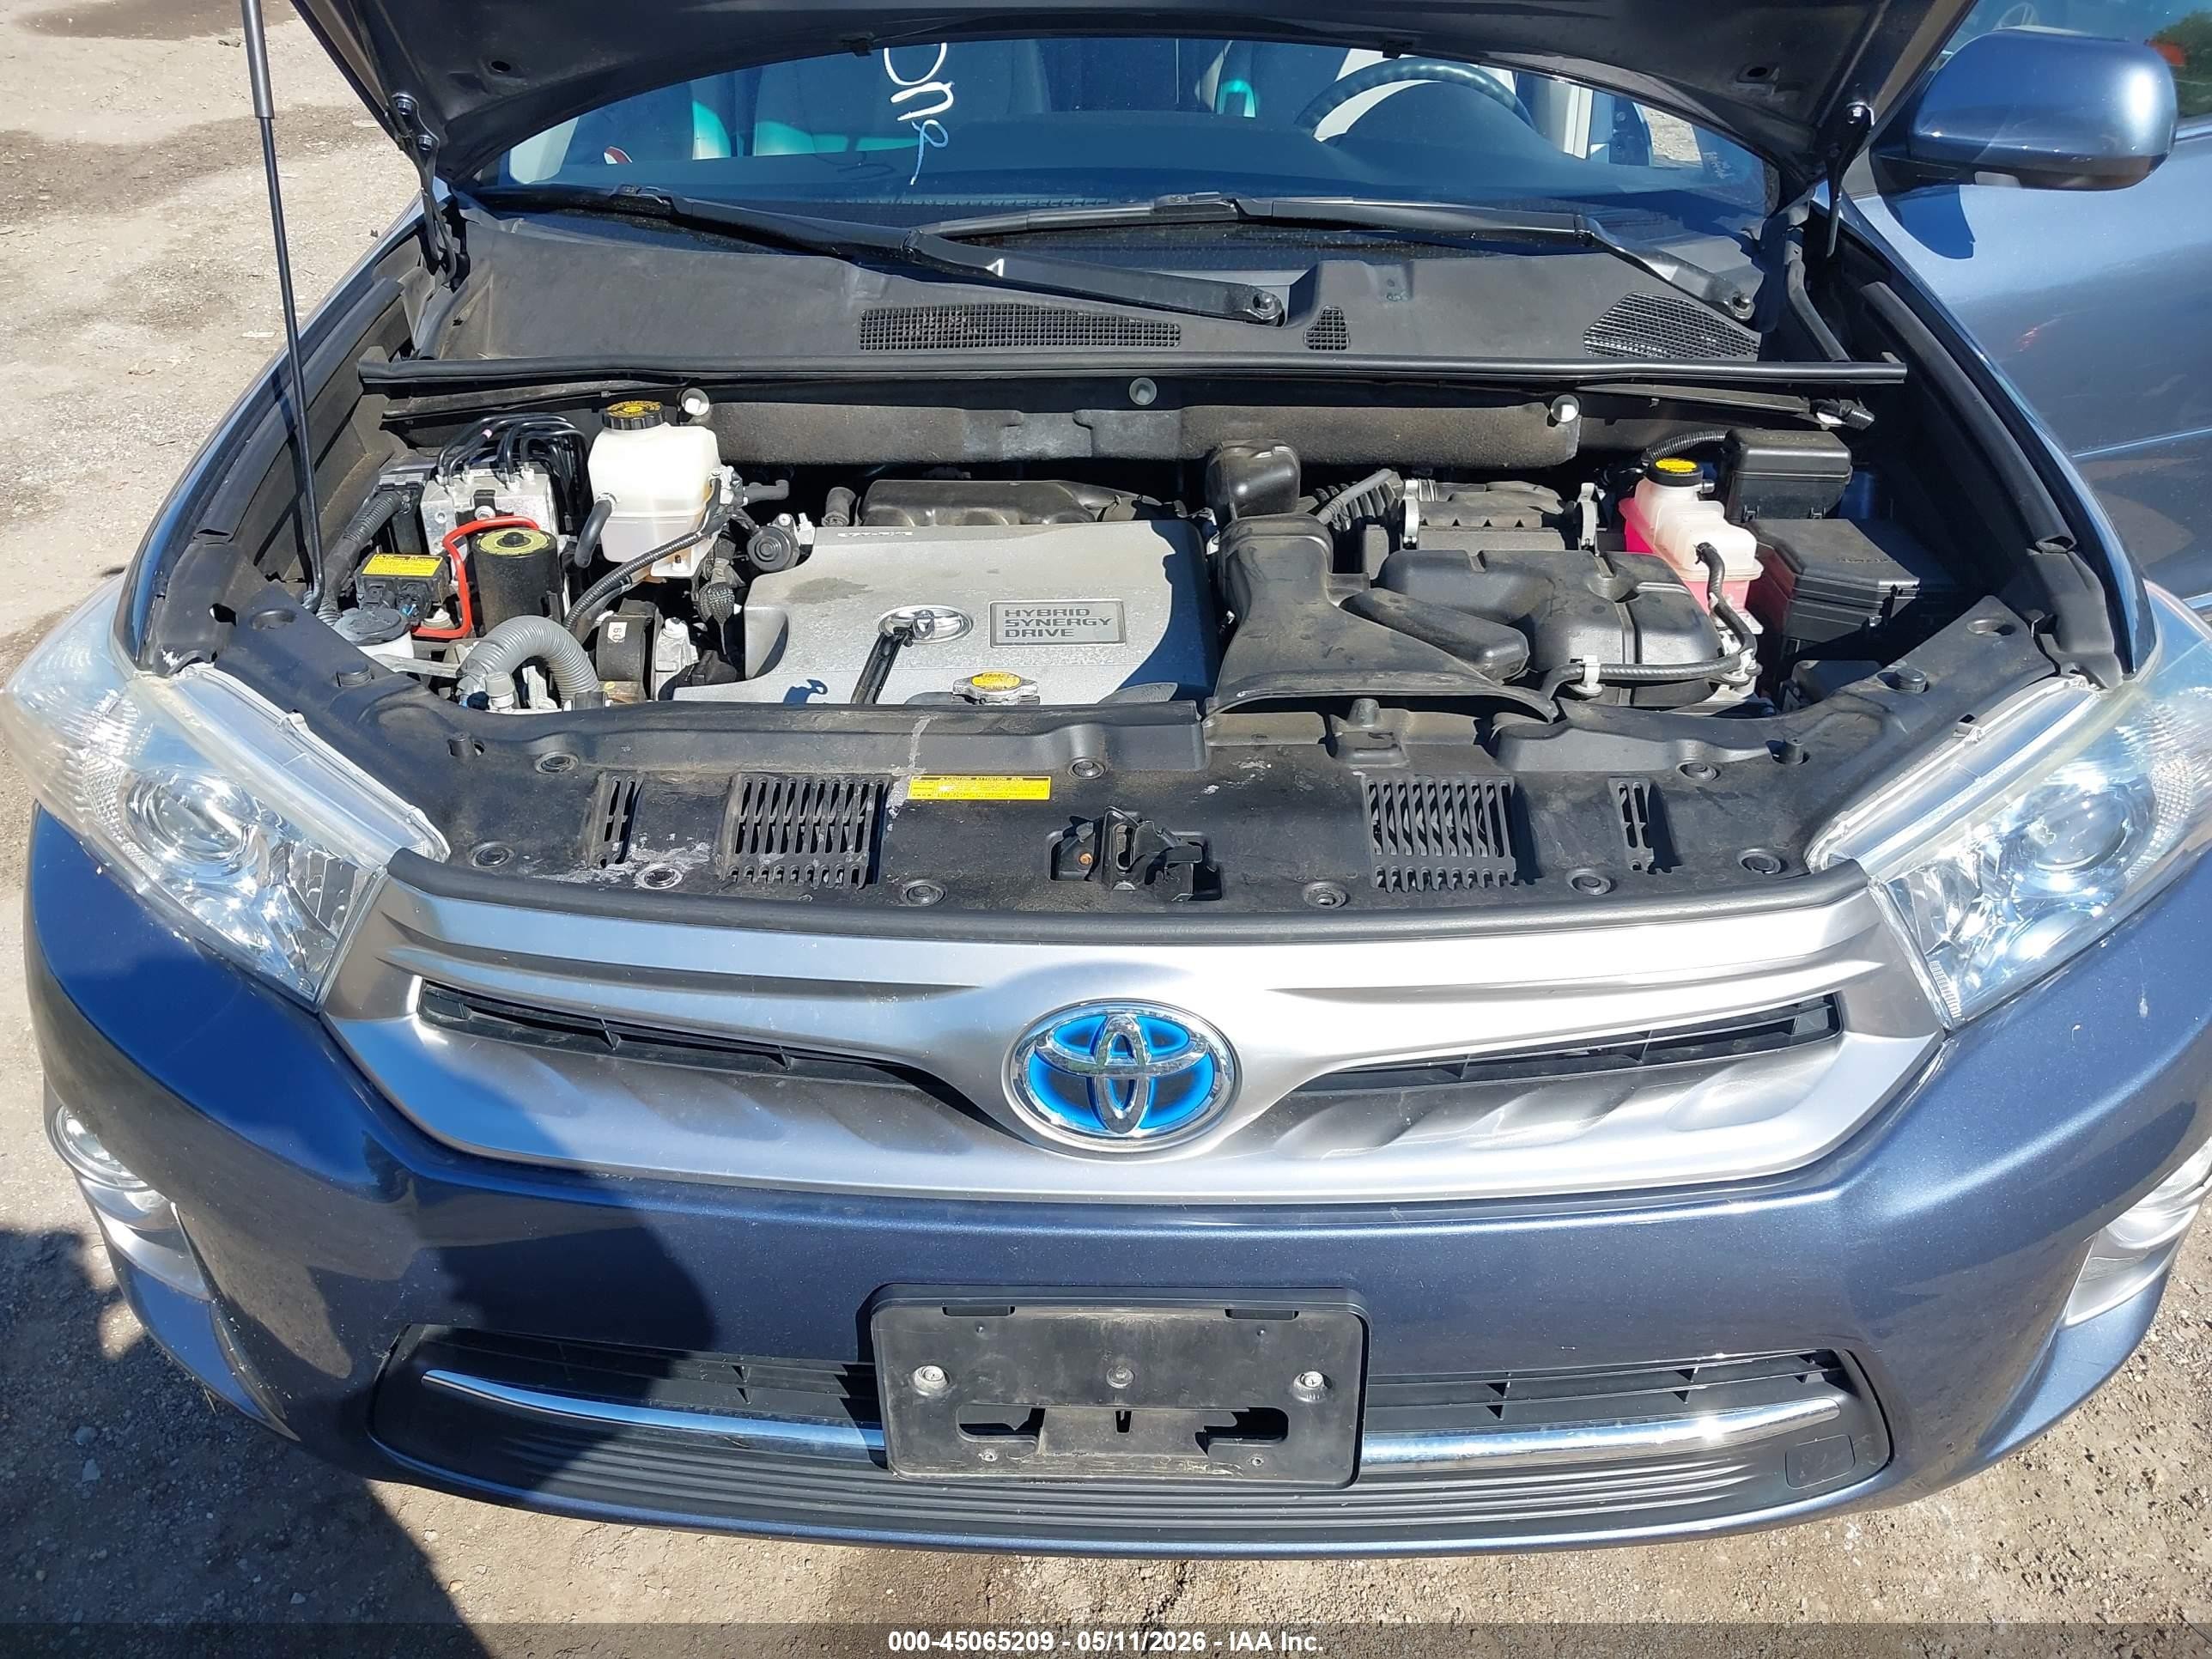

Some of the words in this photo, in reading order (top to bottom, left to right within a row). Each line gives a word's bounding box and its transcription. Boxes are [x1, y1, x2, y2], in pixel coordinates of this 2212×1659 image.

[1004, 608, 1091, 617] HYBRID
[1004, 617, 1113, 628] SYNERGY
[1004, 629, 1075, 638] DRIVE
